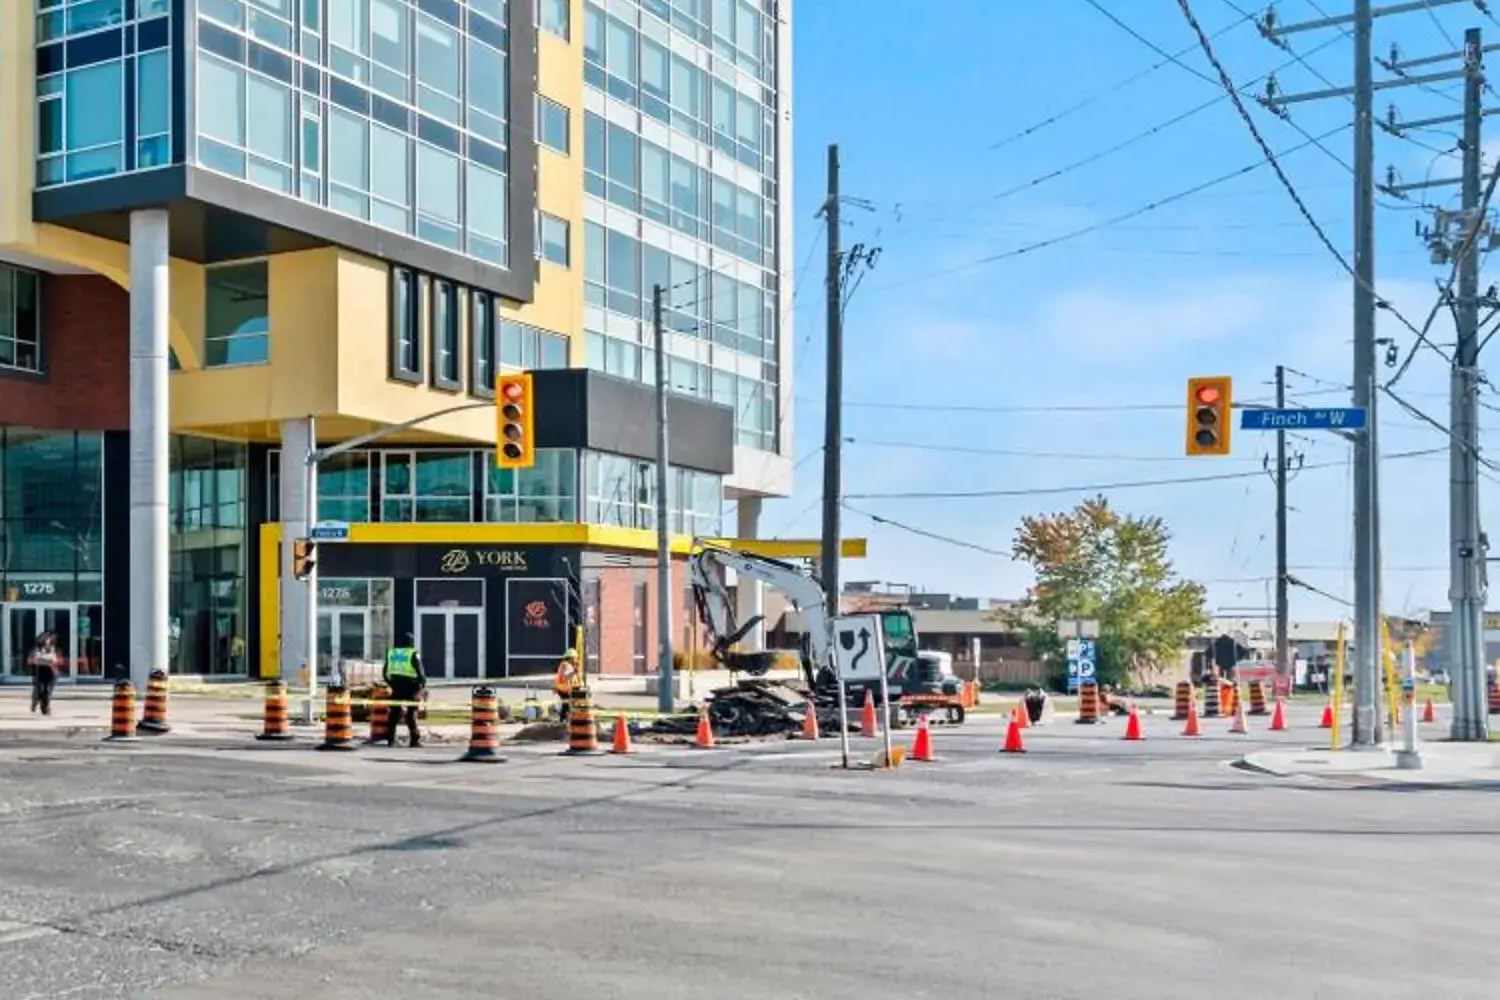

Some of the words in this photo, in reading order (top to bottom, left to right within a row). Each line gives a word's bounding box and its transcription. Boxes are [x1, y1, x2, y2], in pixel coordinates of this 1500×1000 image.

[1261, 410, 1307, 425] Finch
[1329, 409, 1345, 425] W
[475, 551, 527, 565] YORK
